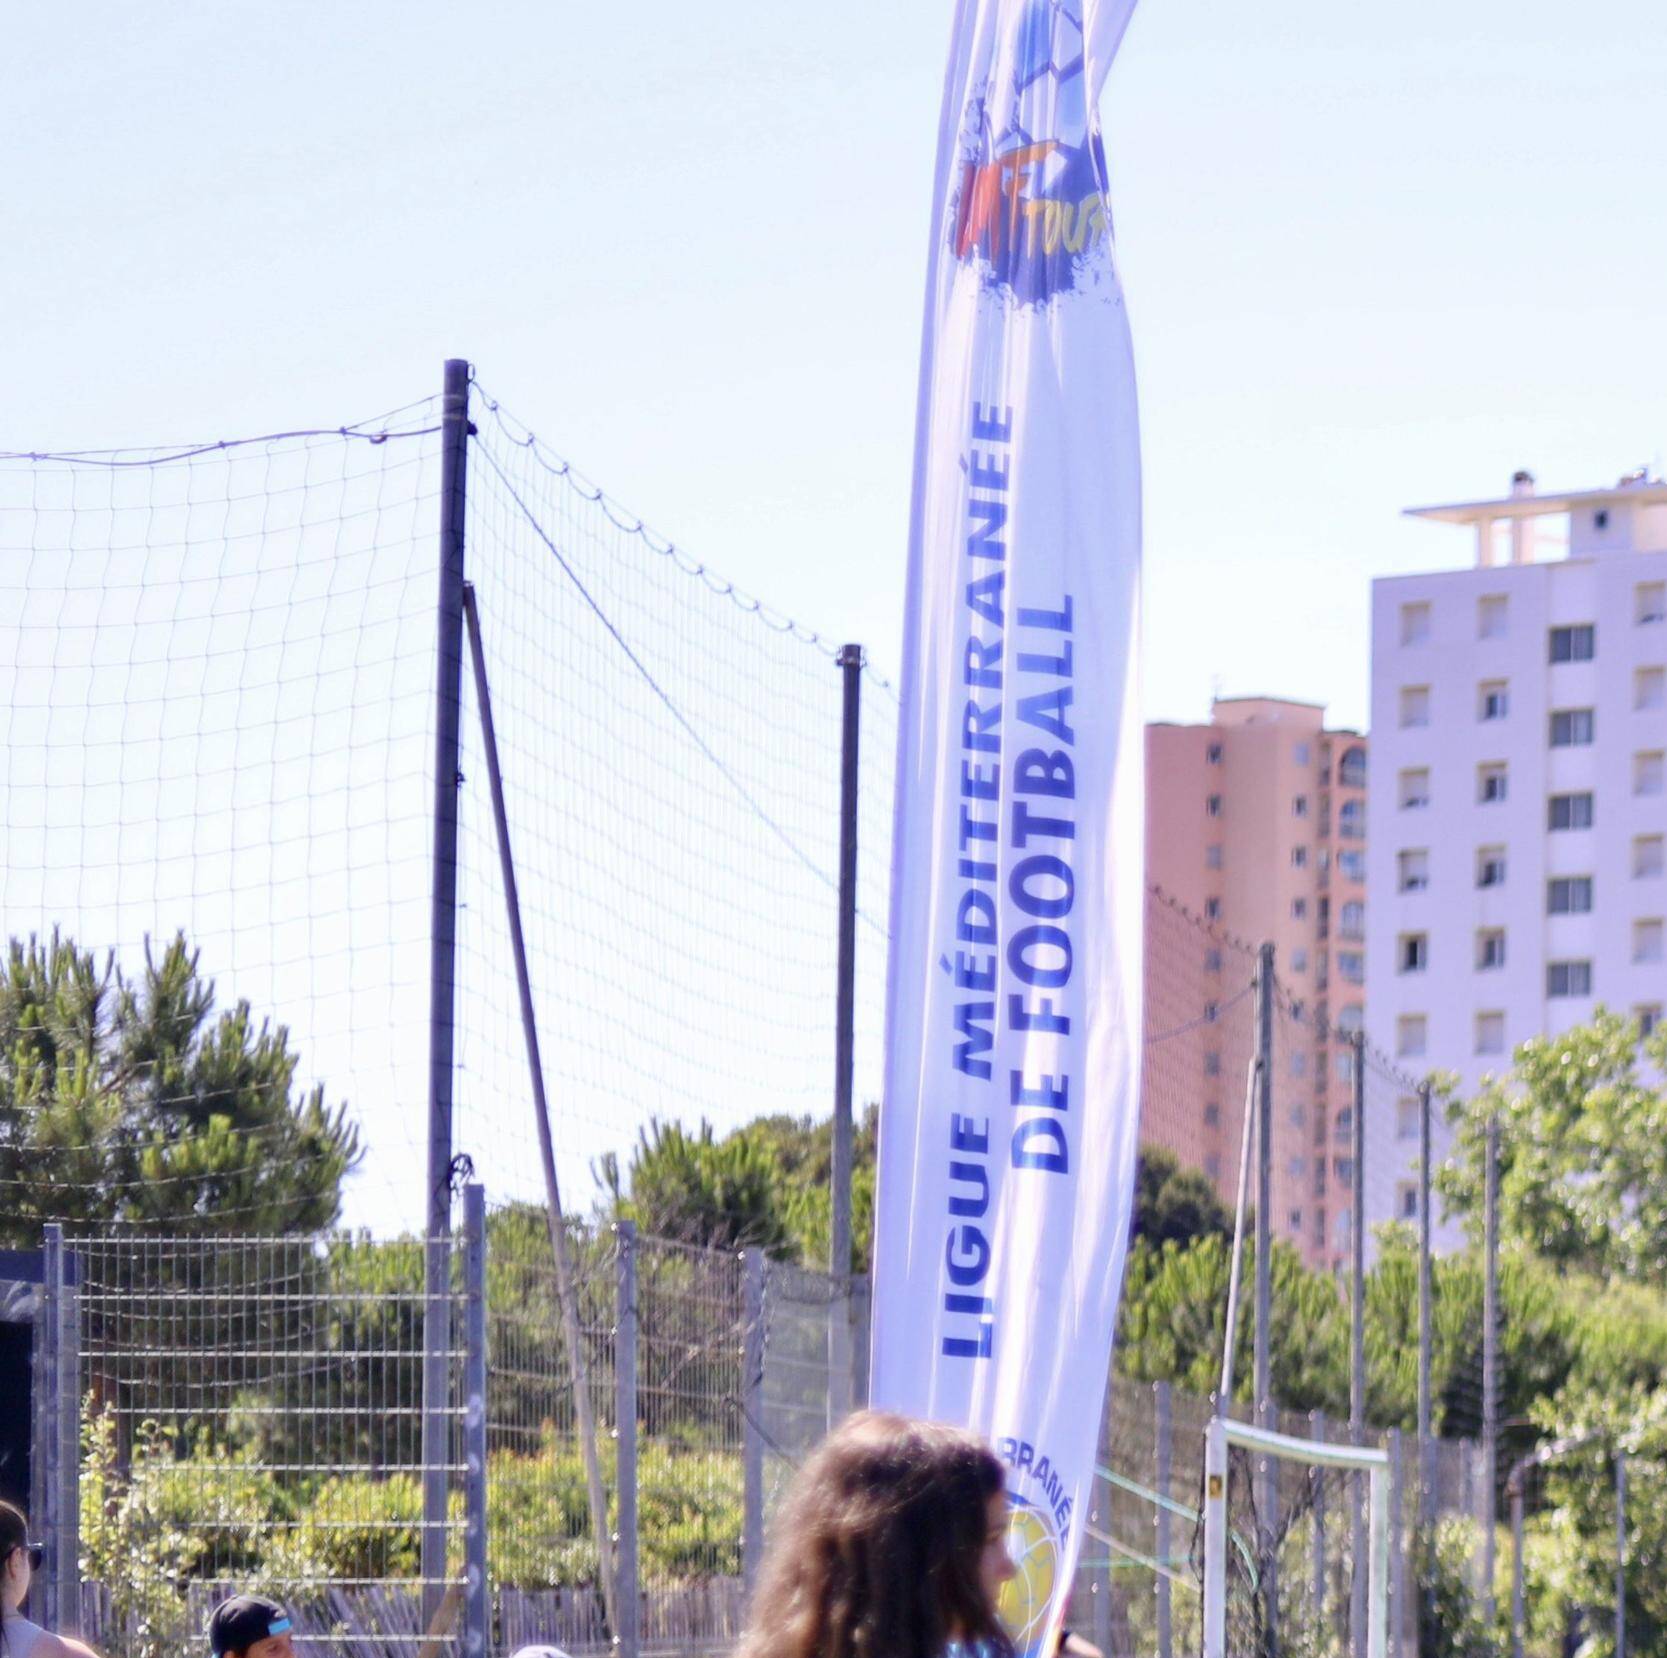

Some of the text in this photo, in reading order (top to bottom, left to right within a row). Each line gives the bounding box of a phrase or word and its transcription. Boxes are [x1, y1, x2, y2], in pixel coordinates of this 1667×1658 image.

[939, 401, 1013, 1359] LIGUE MÉDITERRANÉE
[1007, 594, 1076, 1174] DE FOOTBALL
